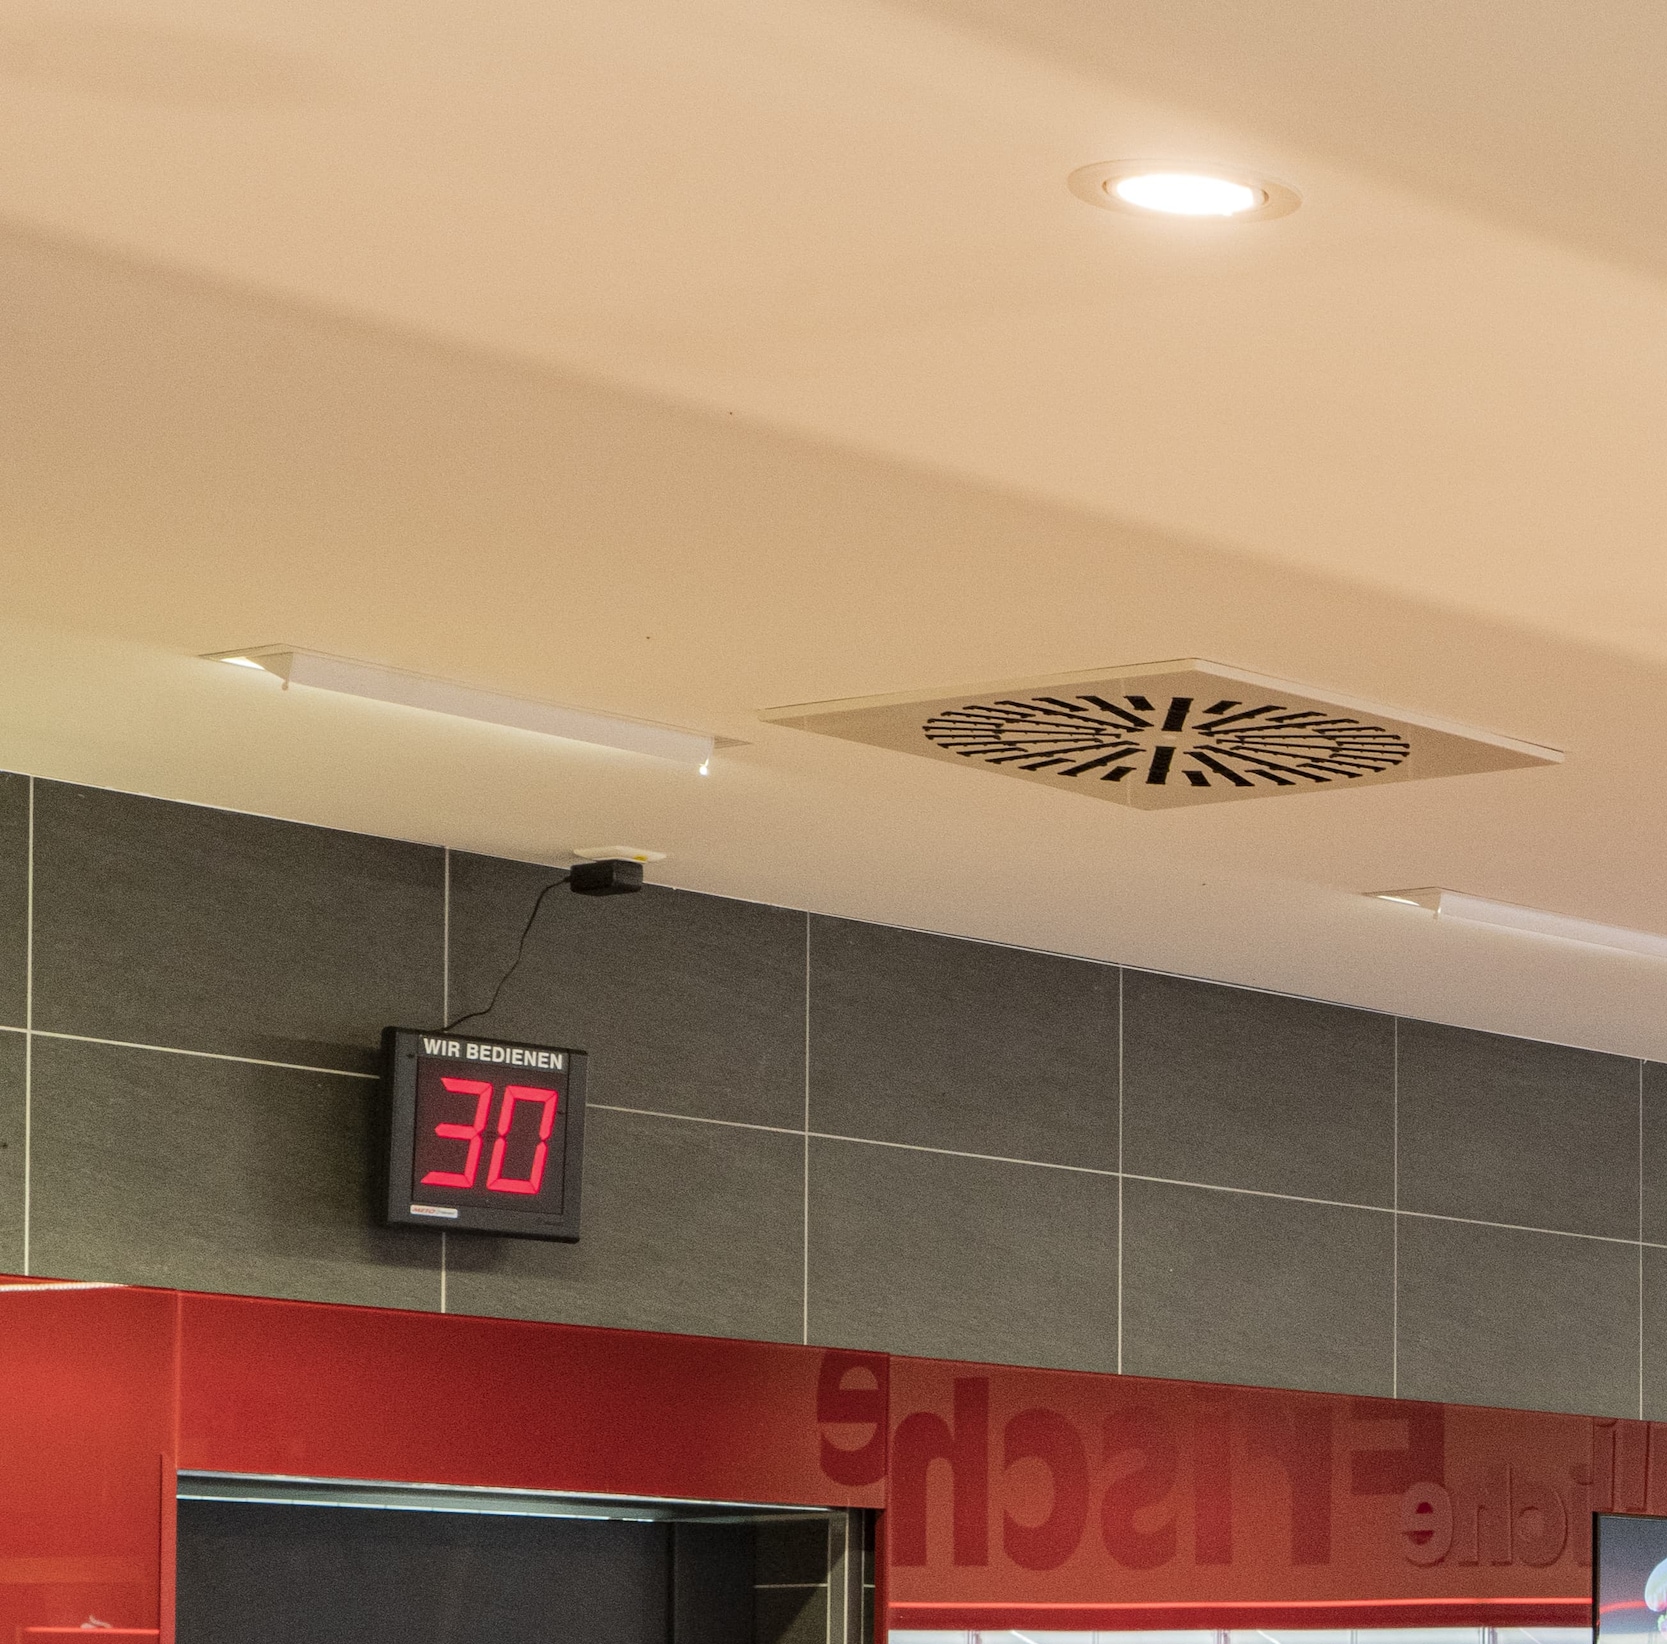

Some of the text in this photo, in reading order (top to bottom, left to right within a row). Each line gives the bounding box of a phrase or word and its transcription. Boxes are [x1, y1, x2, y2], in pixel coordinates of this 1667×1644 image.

[424, 1038, 562, 1070] WIR BEDIENEN
[420, 1077, 558, 1195] 30
